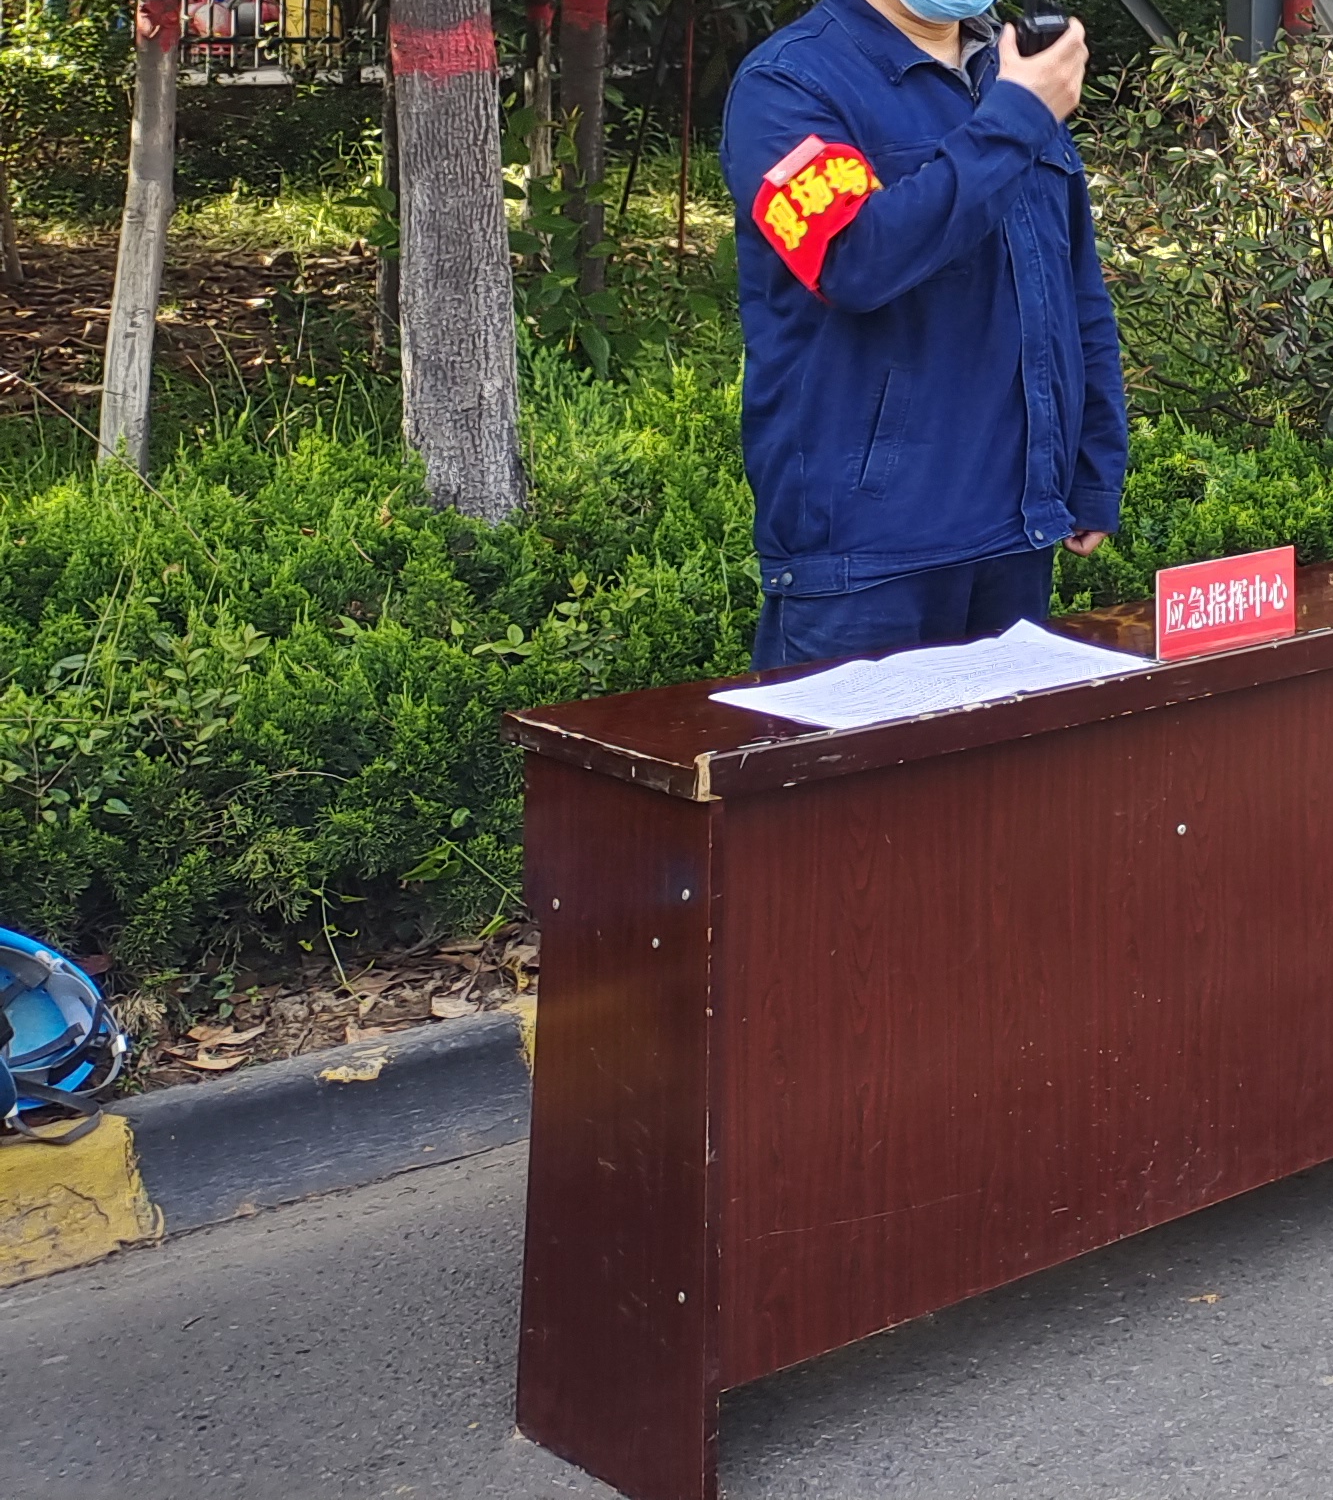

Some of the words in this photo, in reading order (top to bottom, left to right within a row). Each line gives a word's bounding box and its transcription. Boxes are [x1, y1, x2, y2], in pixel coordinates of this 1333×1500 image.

[764, 157, 884, 251] 现场指
[1165, 574, 1288, 634] 应急指挥中心
